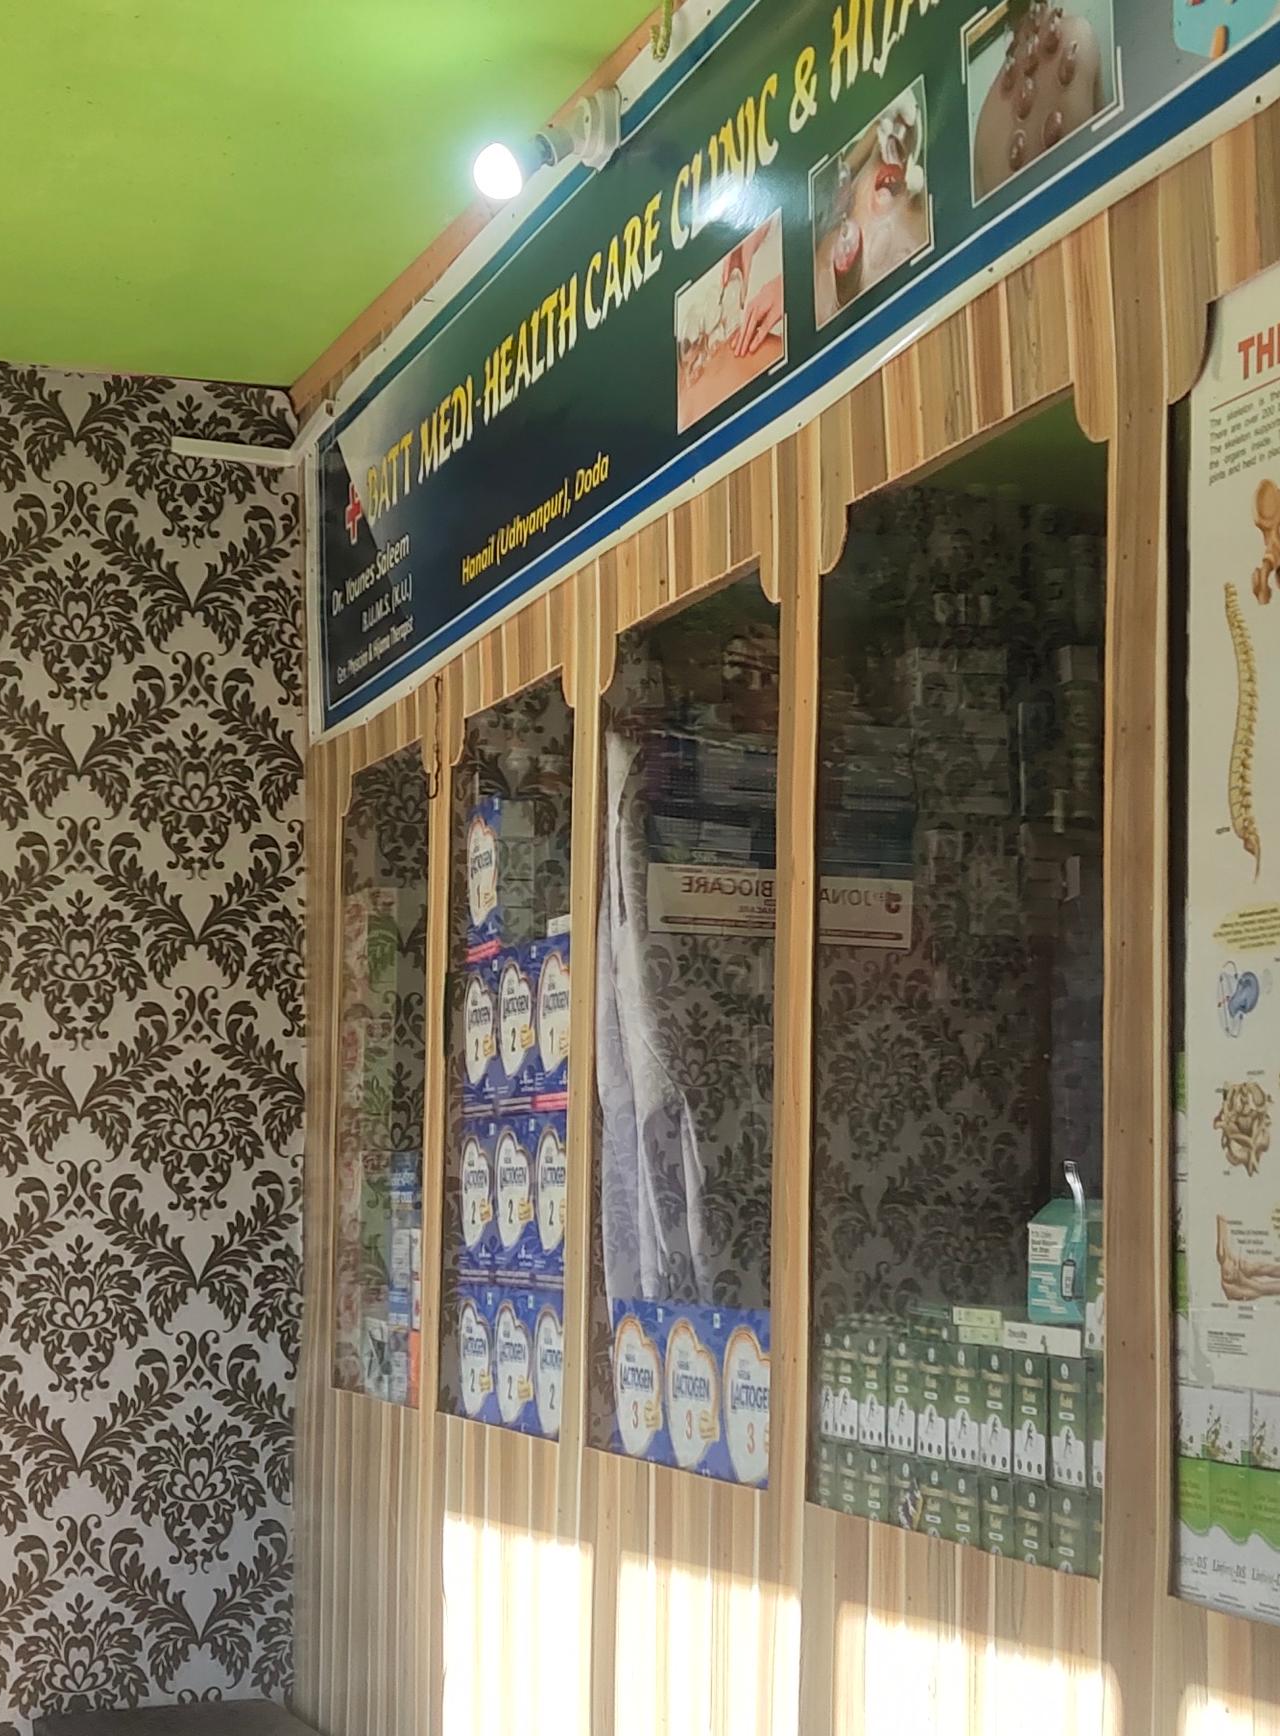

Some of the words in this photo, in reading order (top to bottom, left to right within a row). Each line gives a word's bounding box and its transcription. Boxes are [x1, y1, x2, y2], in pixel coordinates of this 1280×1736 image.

[365, 431, 414, 528] BATT
[584, 191, 663, 330] CARE
[671, 73, 779, 250] CLINIC
[789, 46, 817, 133] &
[574, 452, 610, 501] Doda
[345, 563, 376, 605] Younes
[376, 534, 410, 581] Saleem
[620, 1363, 654, 1393] LACTOGEN
[672, 1370, 710, 1399] LACTOGEN
[730, 1379, 768, 1410] LACTOGE
[631, 1401, 639, 1429] 3
[685, 1410, 693, 1440] 3
[747, 1422, 756, 1454] 3
